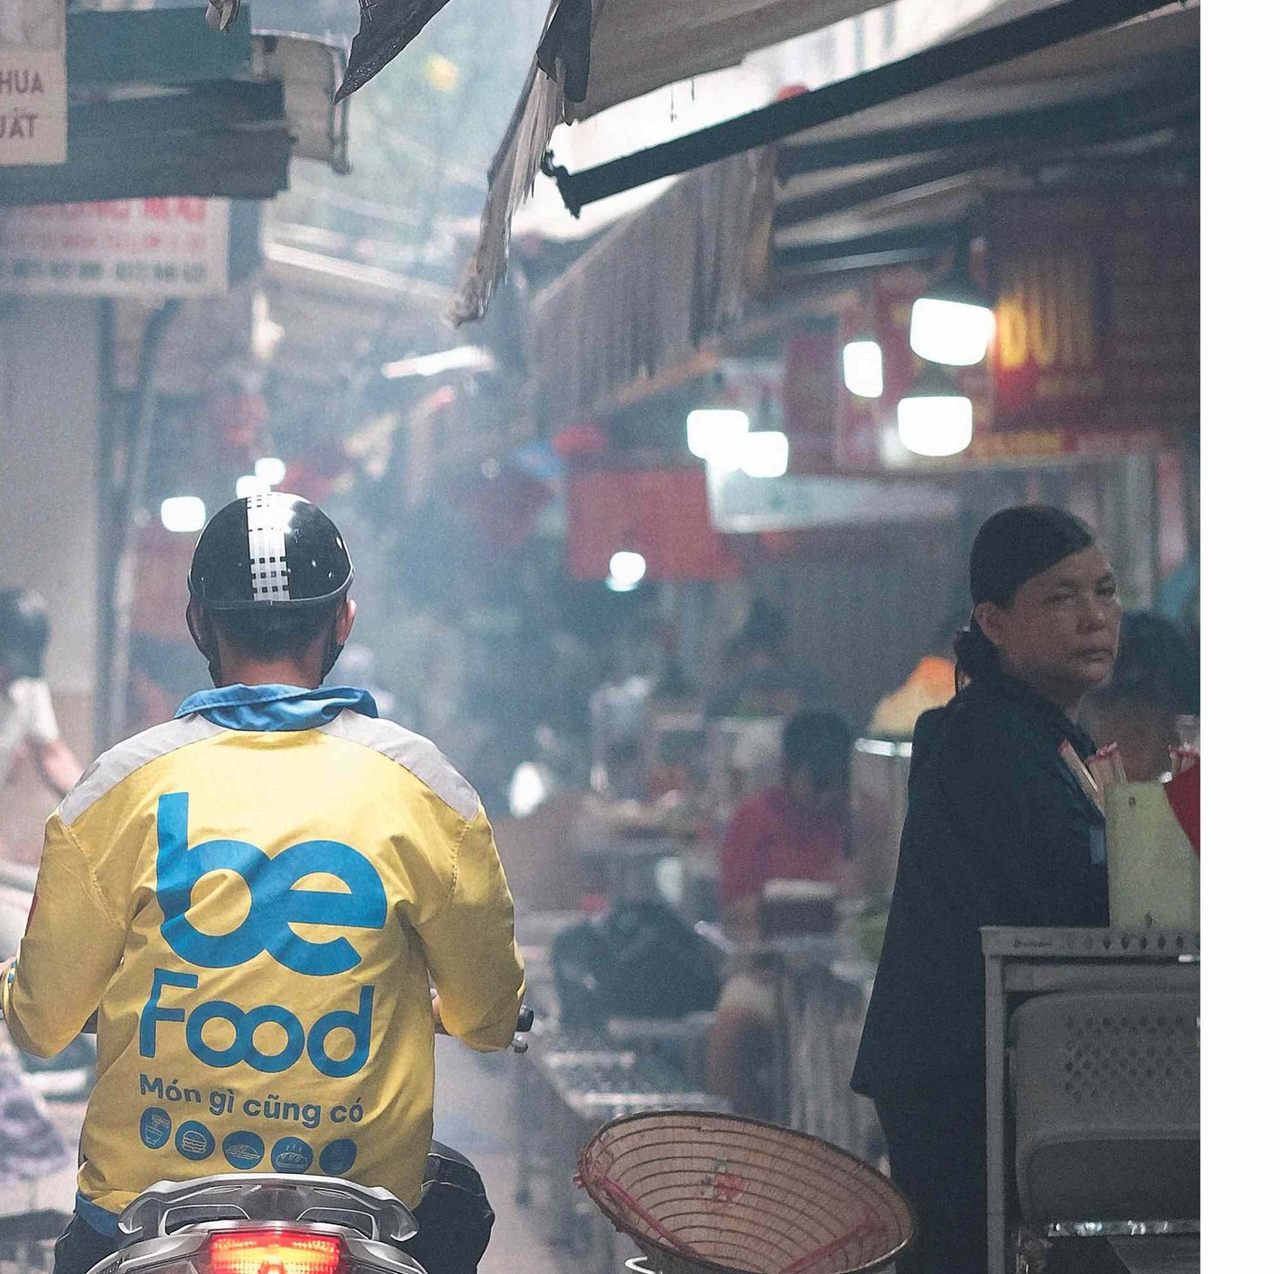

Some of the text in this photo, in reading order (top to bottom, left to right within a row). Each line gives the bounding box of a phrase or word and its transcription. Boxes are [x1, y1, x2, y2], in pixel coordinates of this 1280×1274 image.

[155, 792, 388, 977] be
[139, 968, 375, 1078] Food
[139, 1073, 364, 1129] Món gì cũng có
